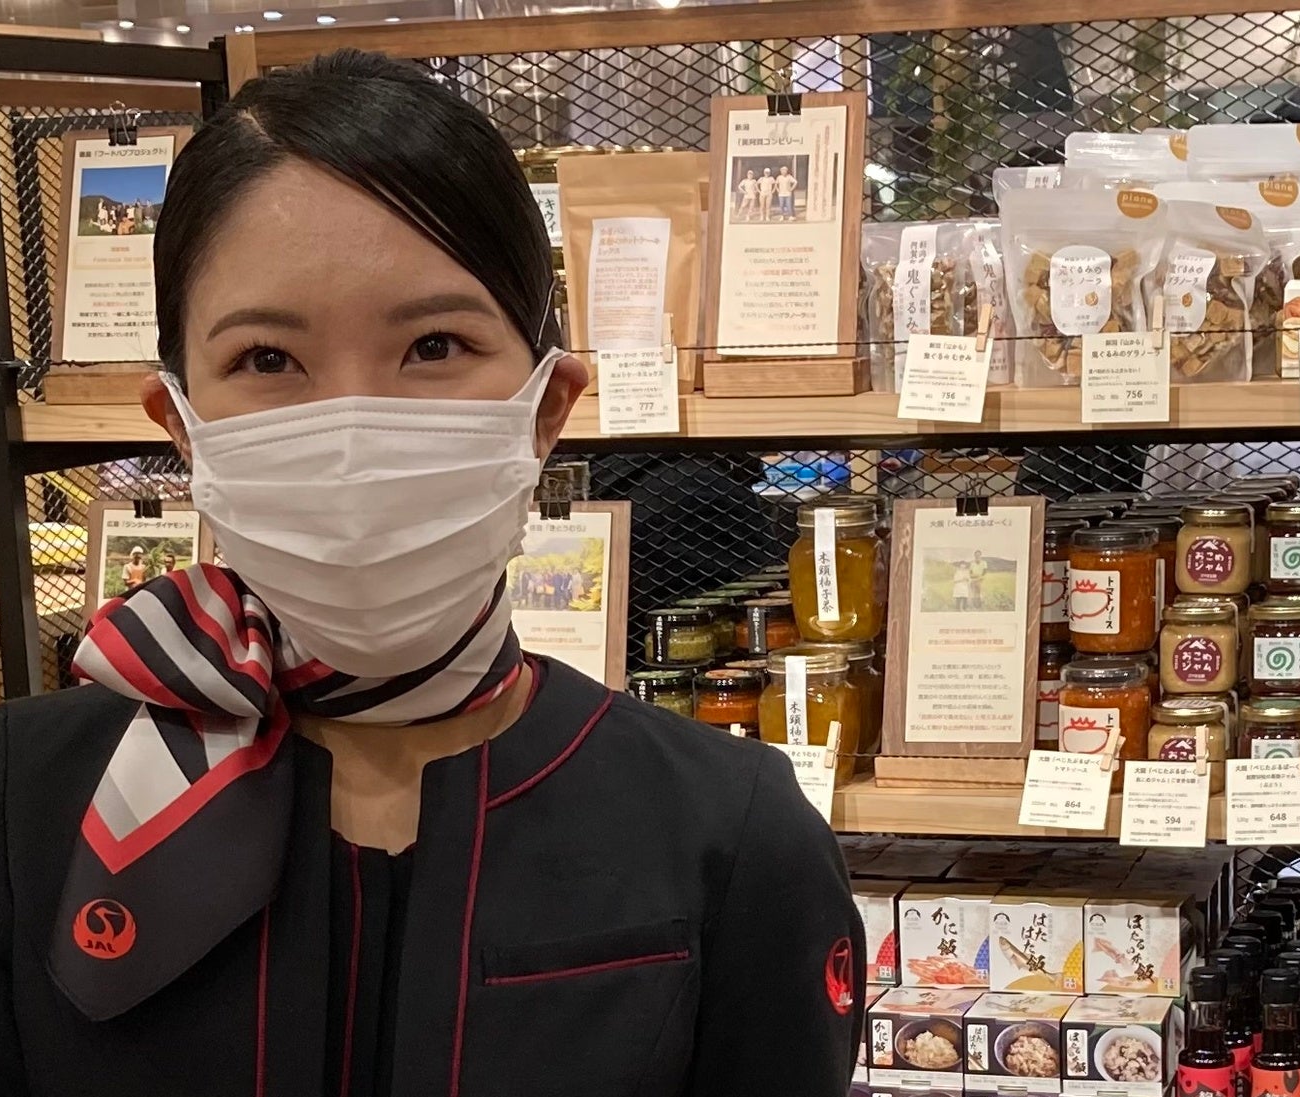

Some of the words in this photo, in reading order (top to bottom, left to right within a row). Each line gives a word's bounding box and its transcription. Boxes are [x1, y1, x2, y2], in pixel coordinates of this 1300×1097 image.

[1126, 389, 1142, 399] 756
[639, 402, 654, 411] 777
[1195, 552, 1225, 561] おこめ
[1195, 562, 1225, 572] ジャム
[818, 551, 834, 614] 木頭柚子茶
[1106, 576, 1115, 630] トマトソース
[1182, 652, 1212, 661] おこめ
[1182, 662, 1212, 672] ジャム
[1165, 816, 1181, 824] 594
[1270, 813, 1287, 821] 648
[931, 906, 958, 958] かに飯
[874, 1021, 889, 1054] かに飯
